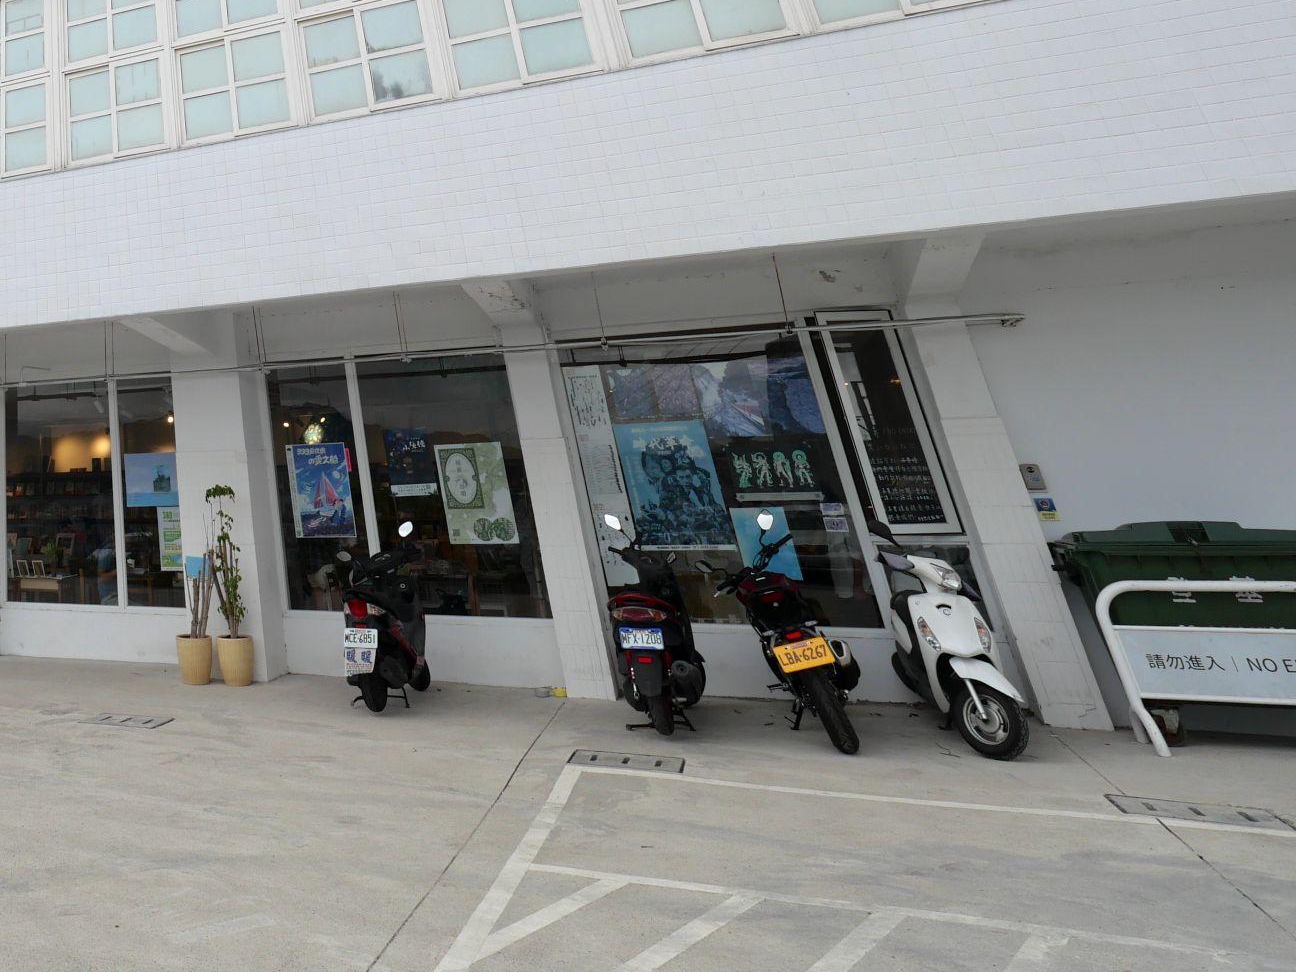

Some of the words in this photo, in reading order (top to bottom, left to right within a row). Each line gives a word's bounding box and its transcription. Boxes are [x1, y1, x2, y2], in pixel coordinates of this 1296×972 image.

[1145, 653, 1226, 672] 請勿進入
[1246, 657, 1278, 673] NO
[1282, 659, 1296, 673] E
